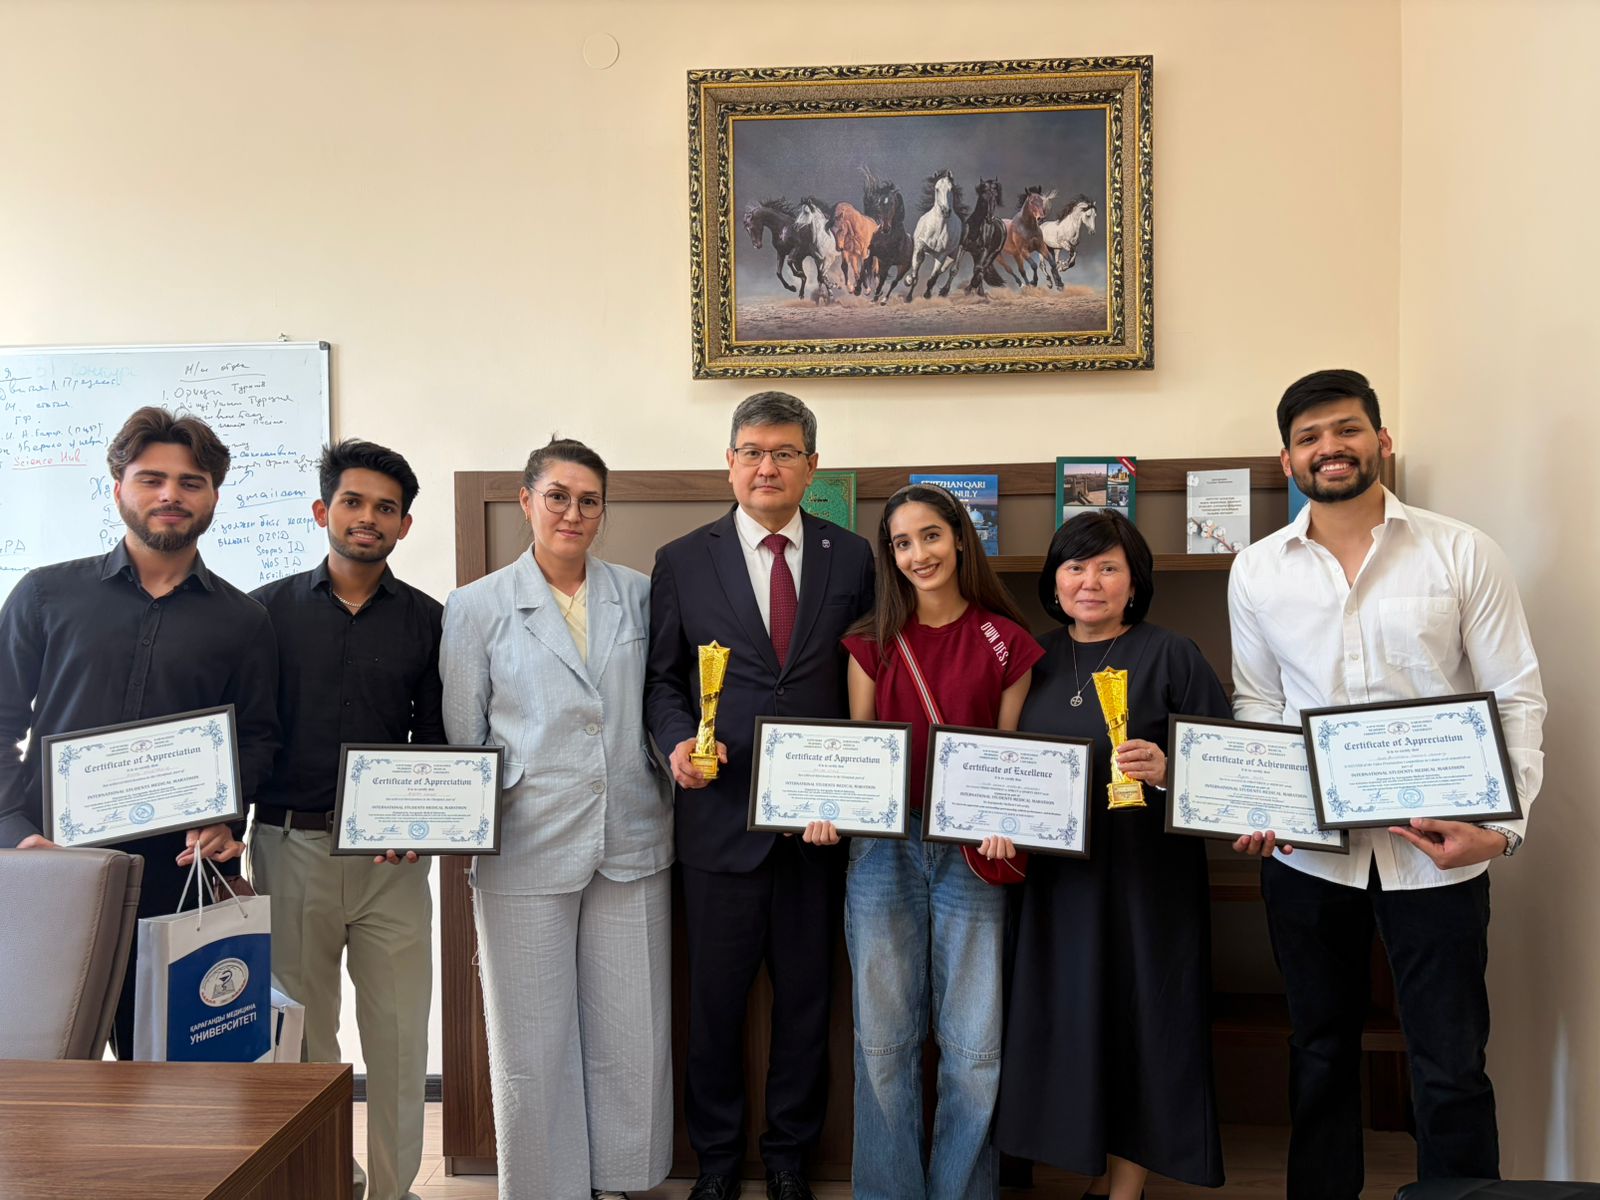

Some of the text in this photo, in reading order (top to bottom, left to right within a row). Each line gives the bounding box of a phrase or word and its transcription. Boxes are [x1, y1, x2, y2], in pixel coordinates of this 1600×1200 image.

[14, 448, 80, 466] Science Hub
[963, 481, 986, 489] QARI
[980, 621, 1001, 644] OWN
[1344, 735, 1464, 751] Certificate of Appreciation
[84, 747, 201, 774] Certificate of Appreciation
[785, 752, 823, 761] Certificate
[834, 754, 881, 764] Appreciation
[1201, 753, 1309, 772] Certificate of Achievement
[962, 762, 1053, 778] Certificate of Excellence
[372, 777, 472, 786] Certificate of Appreciation
[226, 1003, 256, 1020] МЕДИЦИНА
[190, 1011, 257, 1045] УНИВЕРСИТЕТІ
